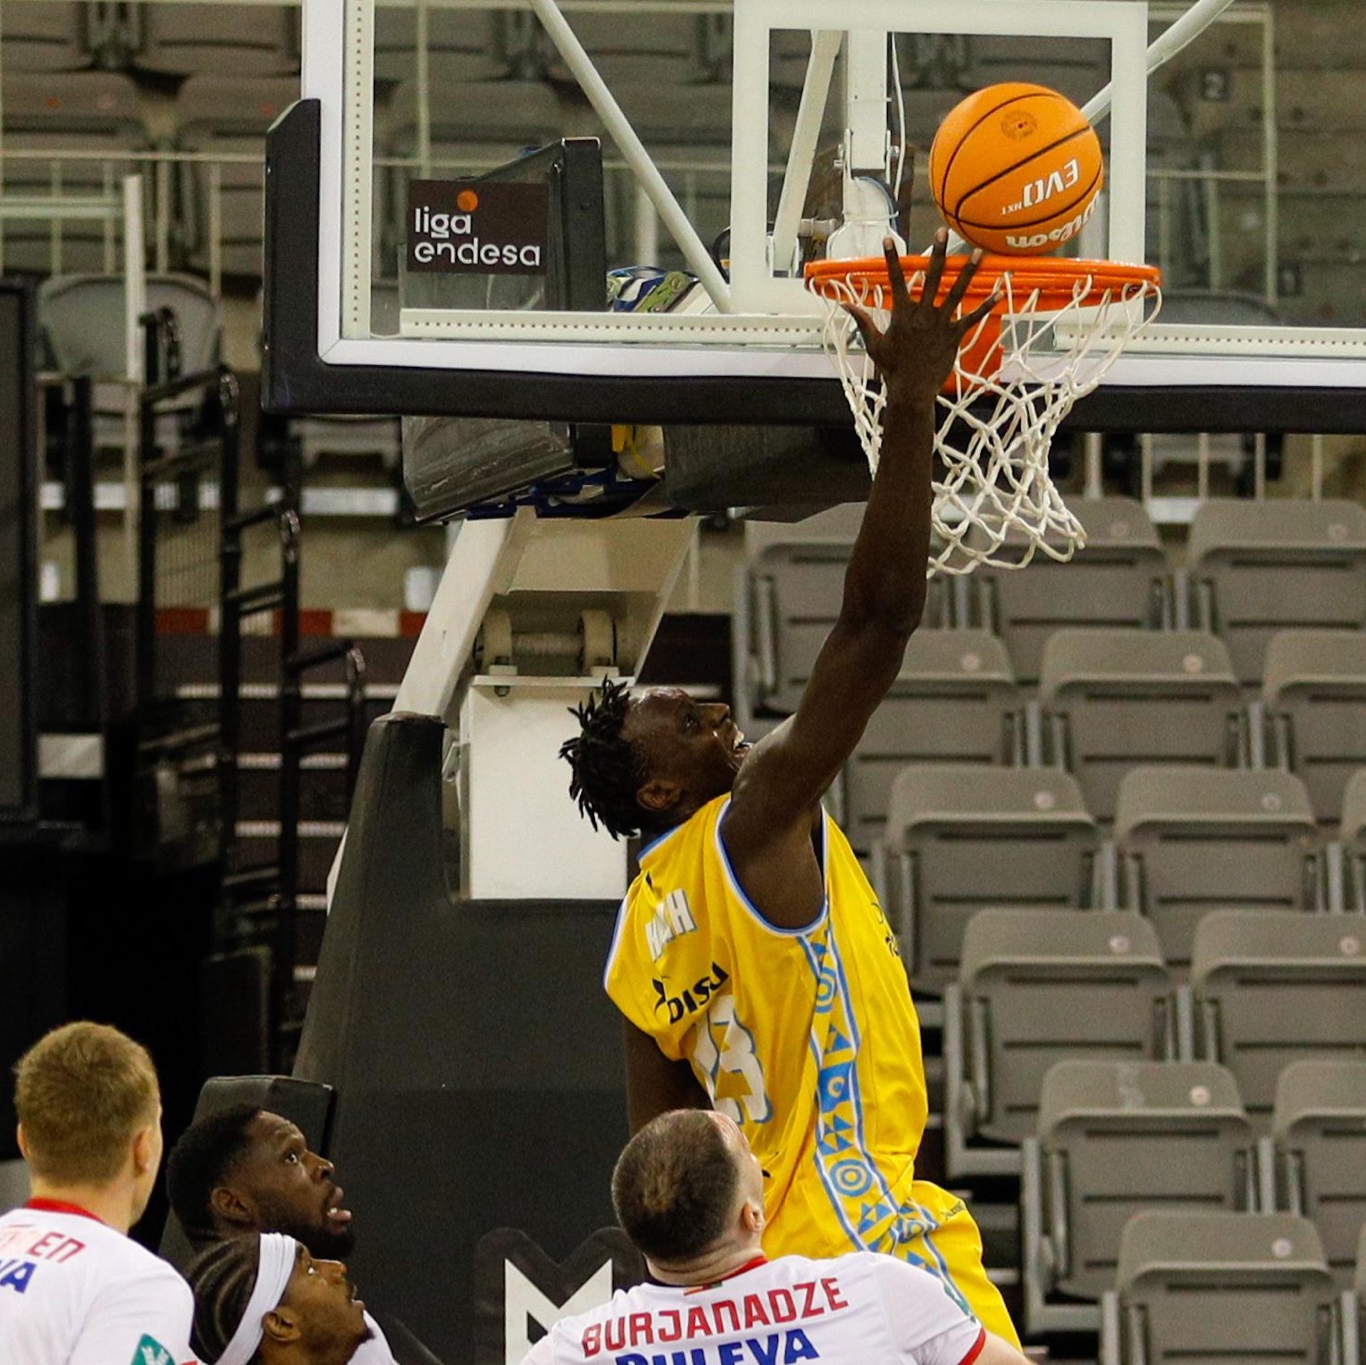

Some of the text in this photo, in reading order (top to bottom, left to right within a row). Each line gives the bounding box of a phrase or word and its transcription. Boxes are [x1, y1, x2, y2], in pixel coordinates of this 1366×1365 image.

[1023, 158, 1079, 207] EVO
[415, 206, 471, 238] liga
[414, 237, 540, 266] endesa
[581, 1276, 849, 1358] BURJANADZE
